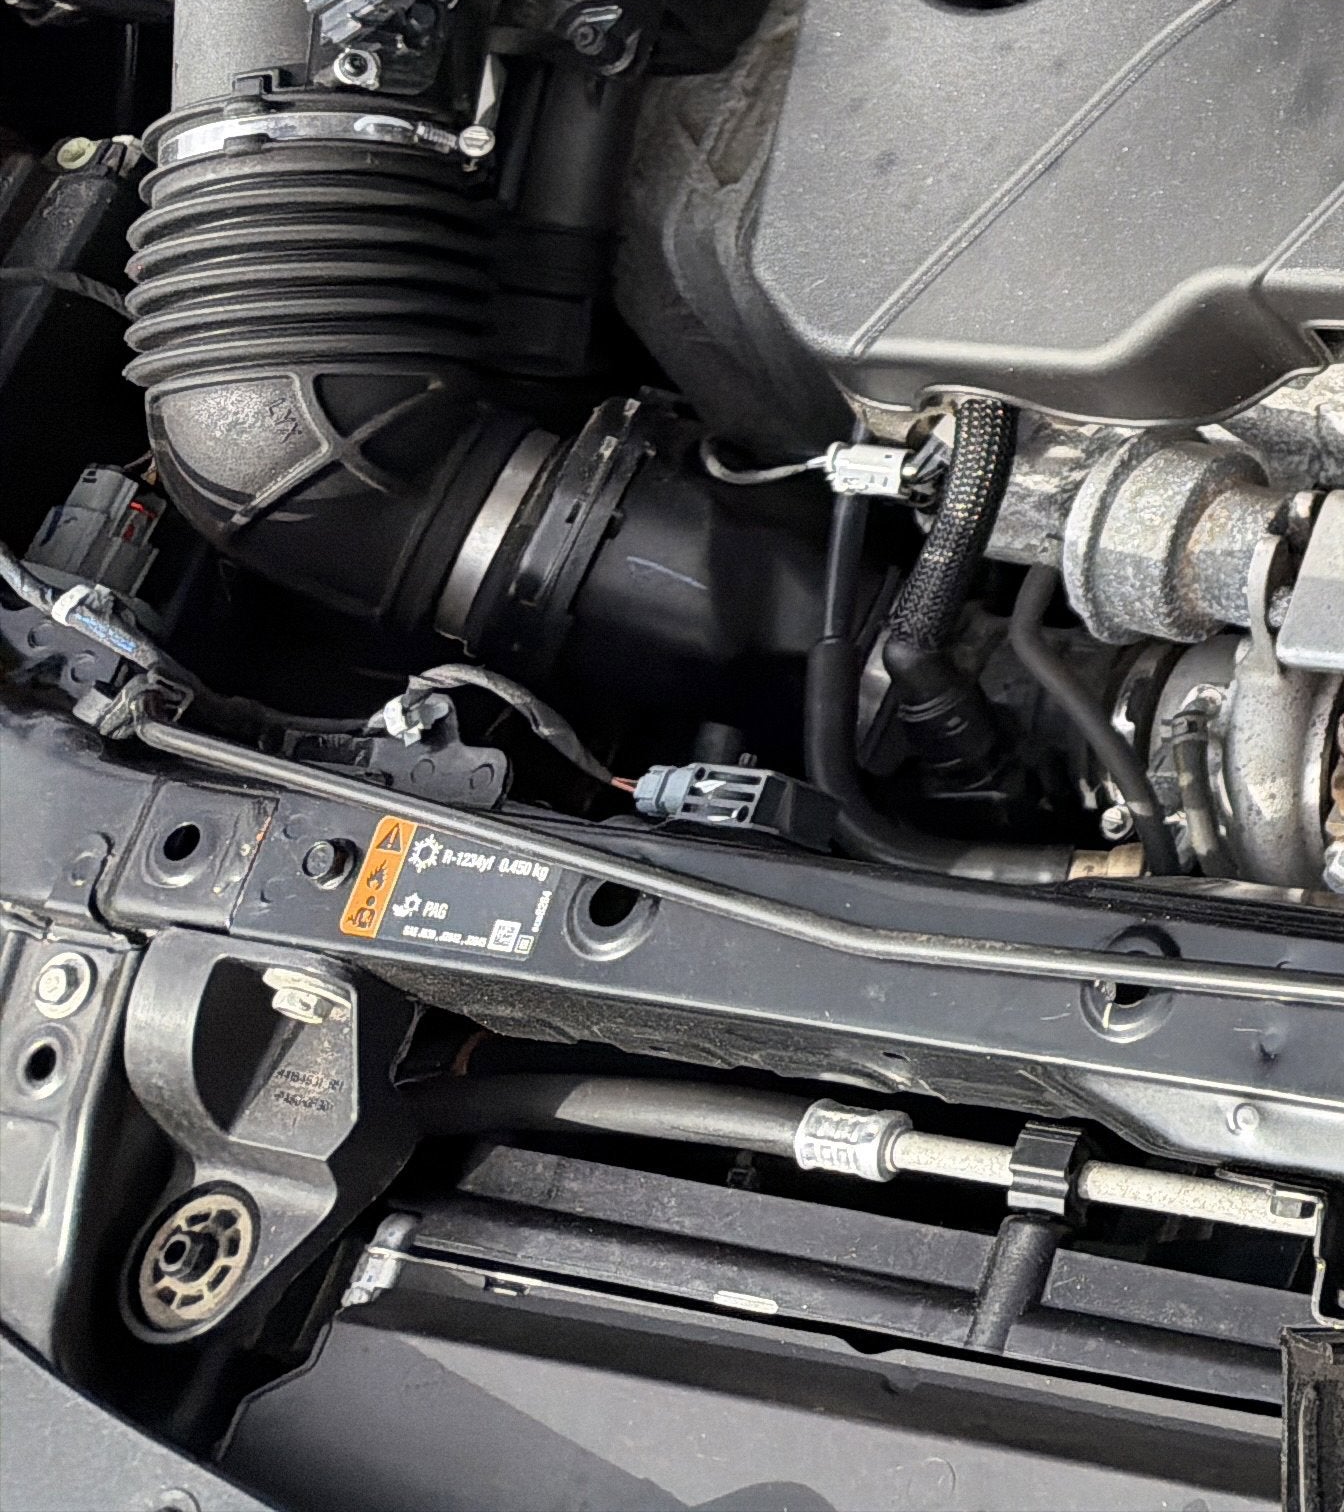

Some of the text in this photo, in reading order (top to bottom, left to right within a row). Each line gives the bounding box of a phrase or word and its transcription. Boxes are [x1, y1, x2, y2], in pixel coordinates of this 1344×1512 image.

[442, 849, 549, 882] R-1234yf 0.450 kg
[422, 900, 450, 920] PAG
